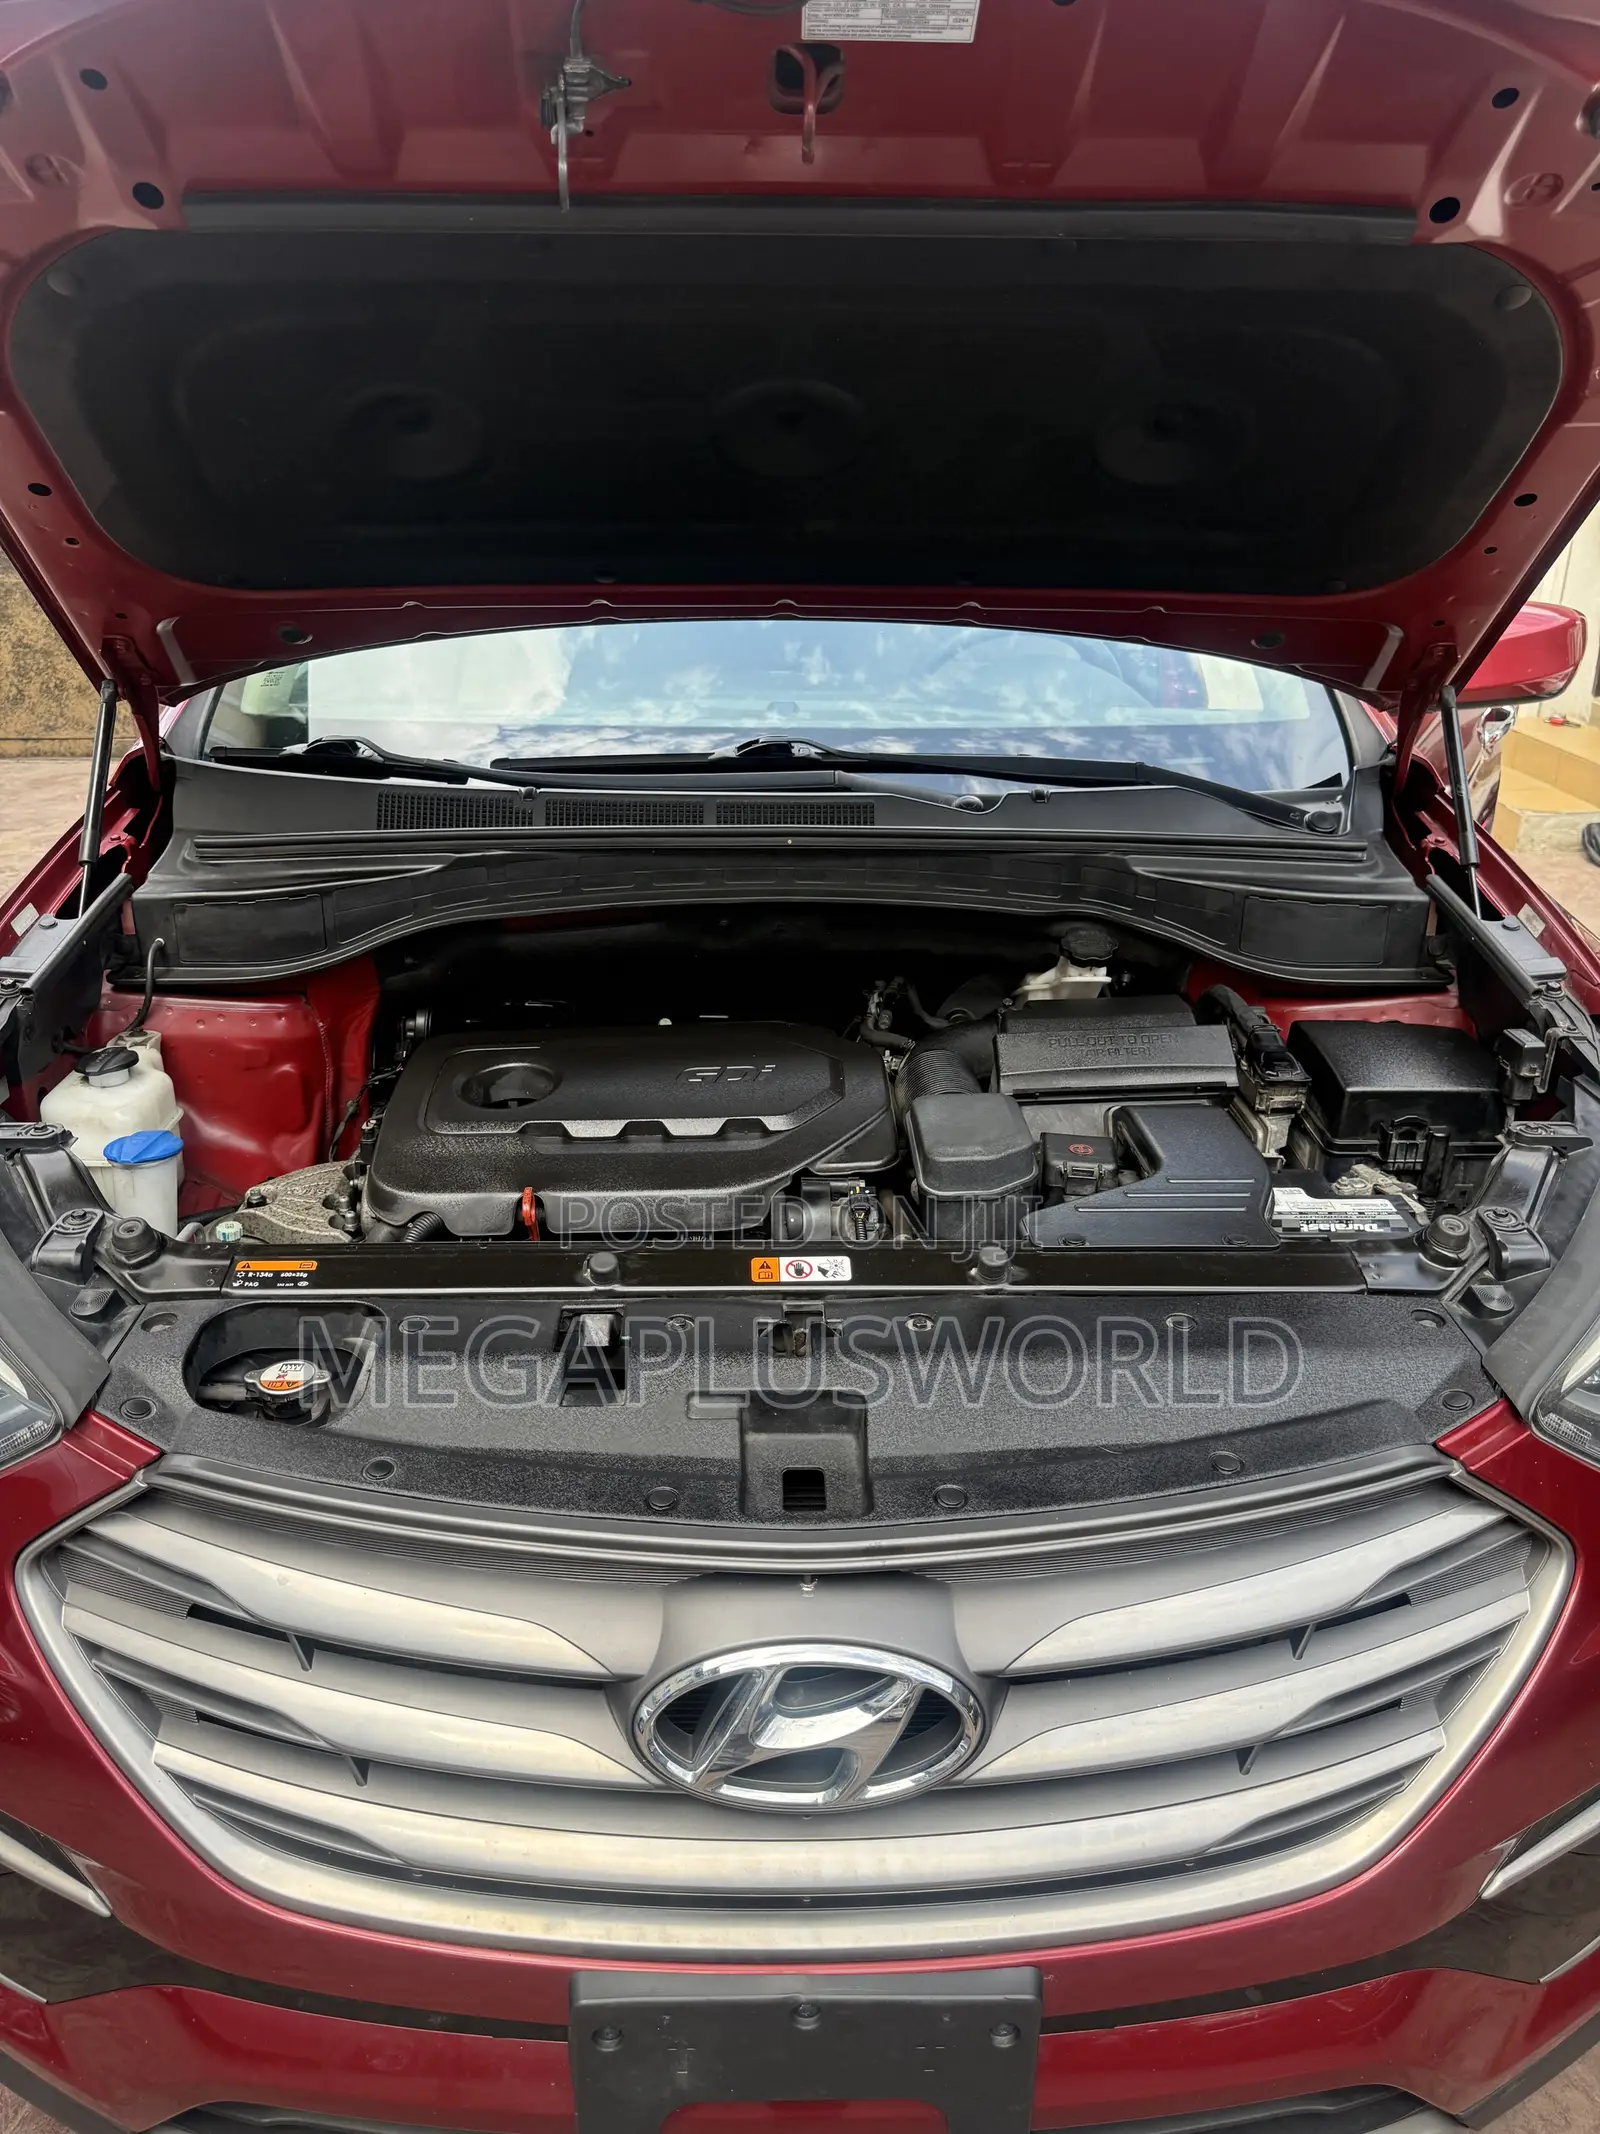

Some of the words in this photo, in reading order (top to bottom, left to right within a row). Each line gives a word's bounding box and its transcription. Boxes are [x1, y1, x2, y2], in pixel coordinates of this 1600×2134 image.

[1086, 1035, 1115, 1046] OUT
[1119, 1034, 1137, 1045] TO
[1141, 1032, 1178, 1044] OPEN
[1299, 1223, 1384, 1232] Duralast
